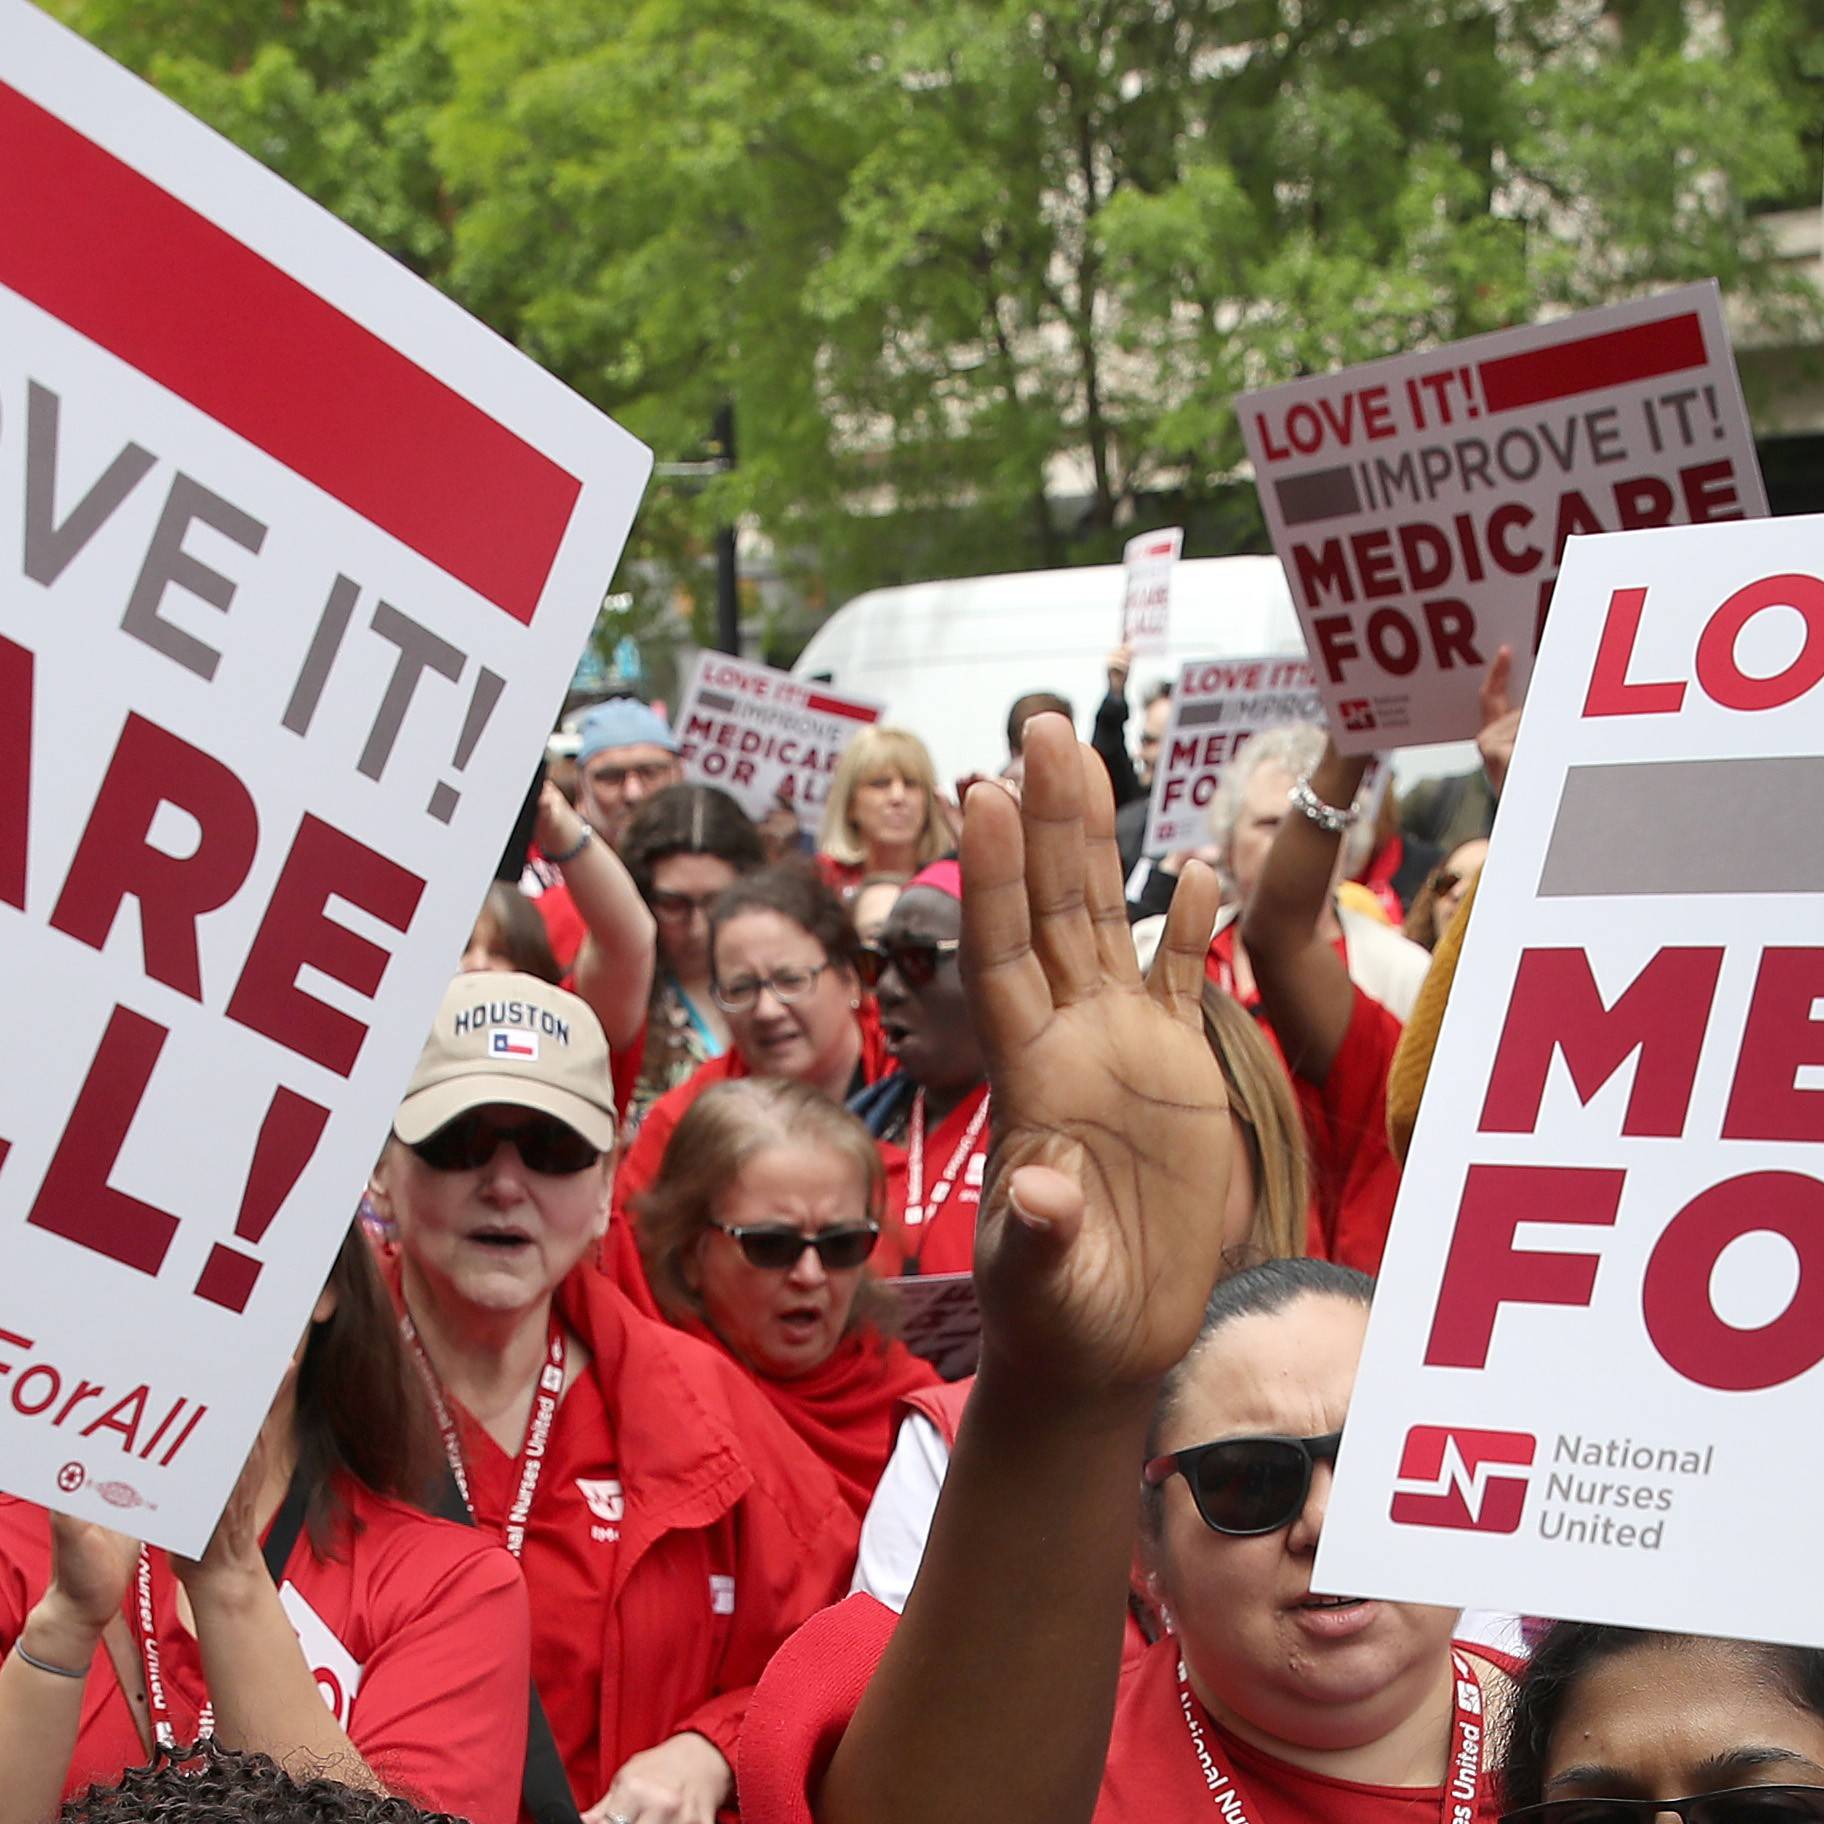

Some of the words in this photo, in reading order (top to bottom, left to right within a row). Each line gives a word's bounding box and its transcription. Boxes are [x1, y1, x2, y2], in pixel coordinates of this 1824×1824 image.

[1255, 386, 1397, 461] LOVE
[1405, 366, 1482, 431] IT!
[1358, 407, 1627, 511] IMPROVE
[1645, 385, 1727, 455] IT!
[1312, 597, 1485, 684] FOR
[281, 573, 507, 826] IT!
[702, 662, 769, 696] LOVE
[1183, 663, 1267, 695] LOVE
[454, 1001, 570, 1047] HOUSTON
[508, 1458, 542, 1523] Nurses
[525, 1394, 556, 1459] United
[1553, 1433, 1714, 1477] National
[1545, 1470, 1674, 1512] Nurses
[1537, 1508, 1664, 1551] United
[1451, 1721, 1480, 1800] United
